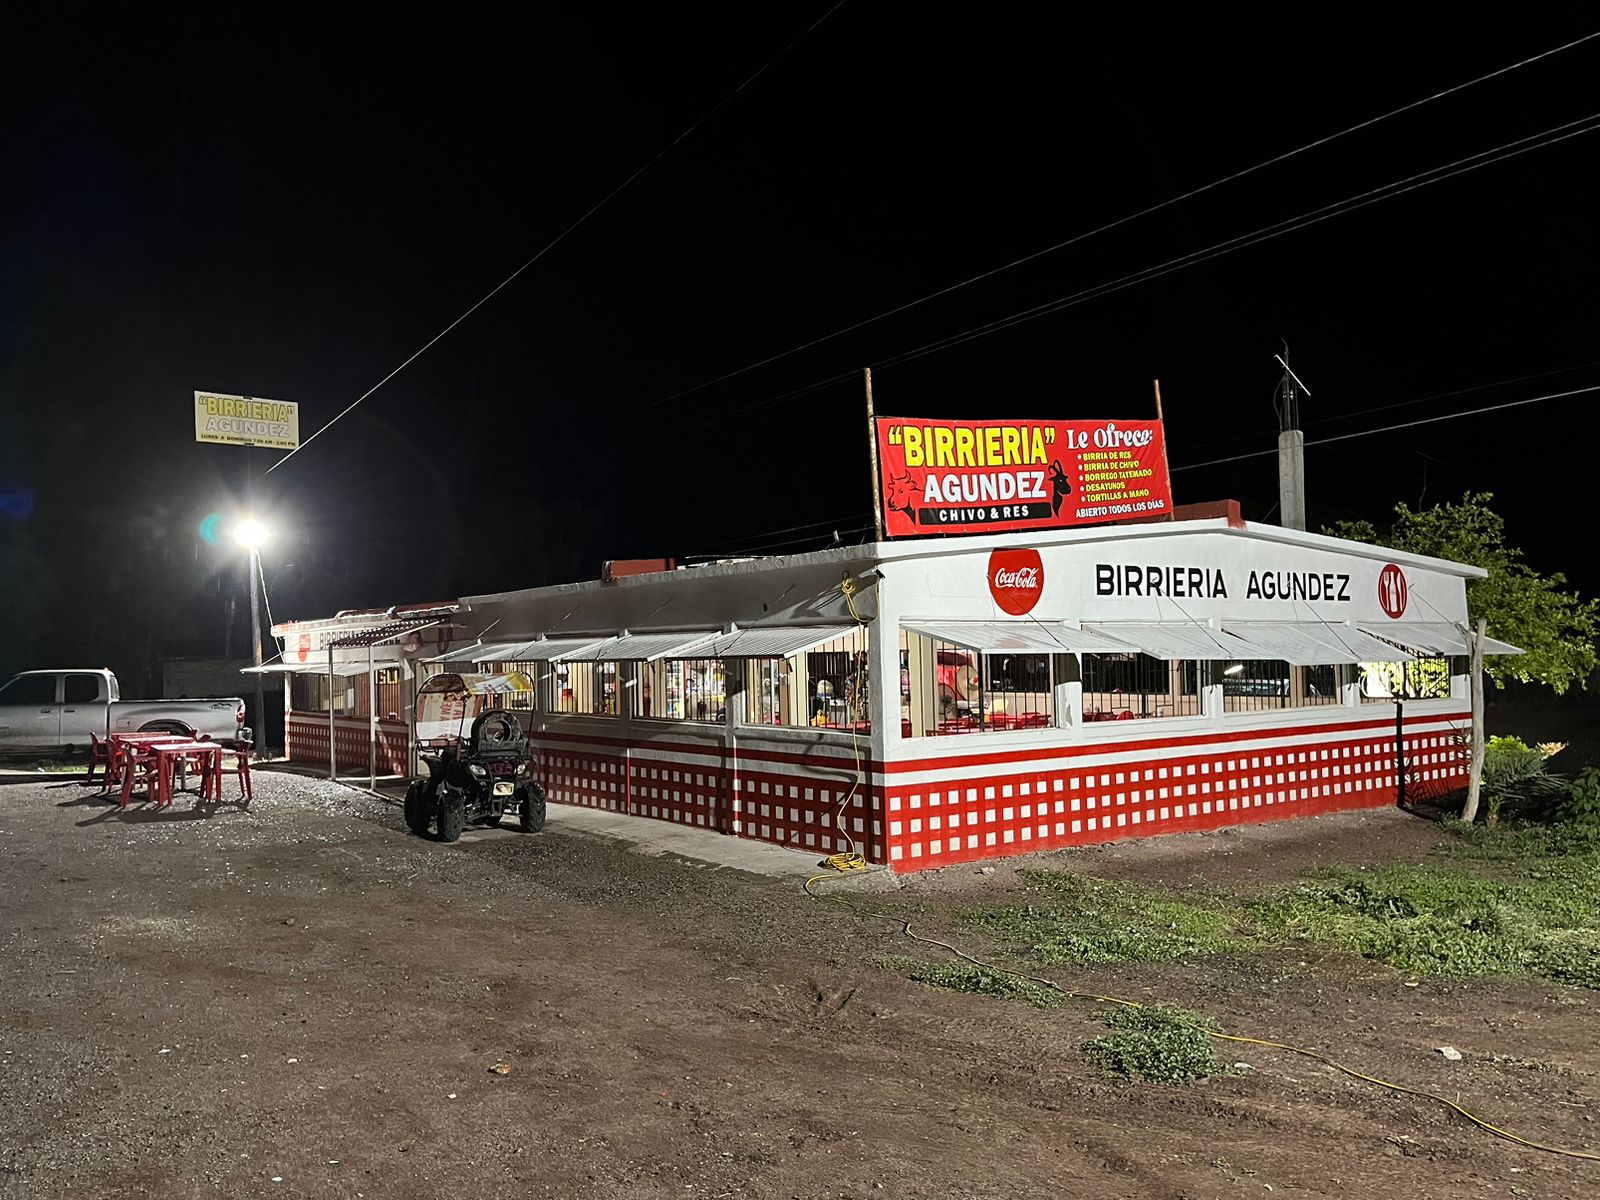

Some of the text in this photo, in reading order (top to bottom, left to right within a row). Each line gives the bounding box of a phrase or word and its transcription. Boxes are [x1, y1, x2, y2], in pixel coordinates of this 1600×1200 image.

[206, 417, 290, 438] AGUNDEZ
[1066, 429, 1088, 449] Le
[1083, 450, 1132, 461] BIRRIA DE RES
[1083, 460, 1140, 471] BIRRIA DE CHIVO
[1084, 469, 1152, 482] BORREGO TATEMADO
[923, 471, 1047, 503] AGUNDEZ
[1085, 482, 1126, 492] DESAYUNOS
[1086, 489, 1149, 502] TORTILLAS A MANO
[939, 505, 1029, 522] CHIVO & RES
[1075, 507, 1107, 518] ABIERTO
[1108, 504, 1132, 515] TODOS
[1133, 502, 1146, 512] LOS
[995, 567, 1039, 588] Coca-Cola
[1095, 563, 1351, 601] BIRRIERIA AGUNDEZ
